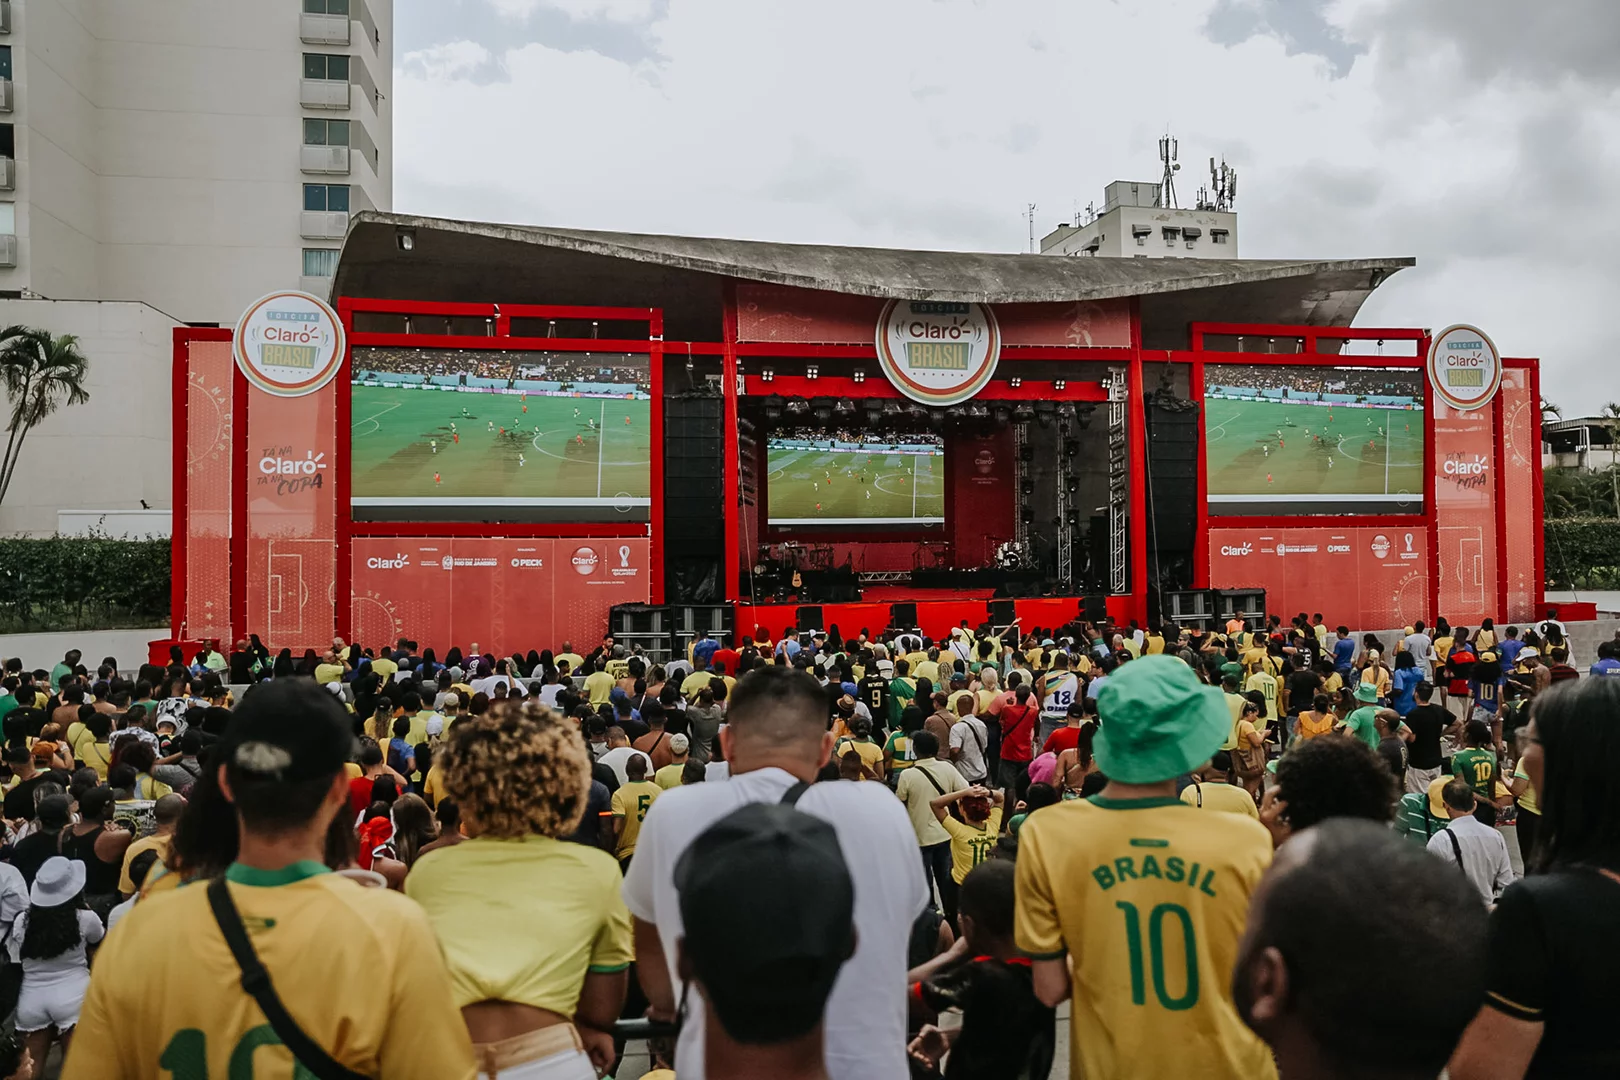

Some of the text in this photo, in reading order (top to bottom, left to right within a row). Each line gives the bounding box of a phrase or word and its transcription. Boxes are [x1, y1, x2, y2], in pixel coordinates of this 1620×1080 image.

[264, 327, 315, 343] Claro
[909, 319, 967, 339] Claro
[263, 345, 312, 367] BRASIL
[911, 343, 966, 369] BRASIL
[1447, 353, 1482, 366] Claro
[1449, 370, 1482, 386] BRASIL
[259, 453, 323, 474] Claro
[1444, 457, 1486, 474] Claro
[277, 473, 323, 496] COPA
[1221, 543, 1251, 556] Claro
[367, 554, 408, 569] Claro
[520, 559, 543, 567] PECK
[572, 556, 597, 565] Claro
[872, 689, 881, 708] 9
[1053, 690, 1071, 705] 18
[1480, 683, 1494, 700] 10
[1473, 761, 1492, 781] 10
[1092, 855, 1217, 897] BRASIL
[1115, 900, 1200, 1011] 10
